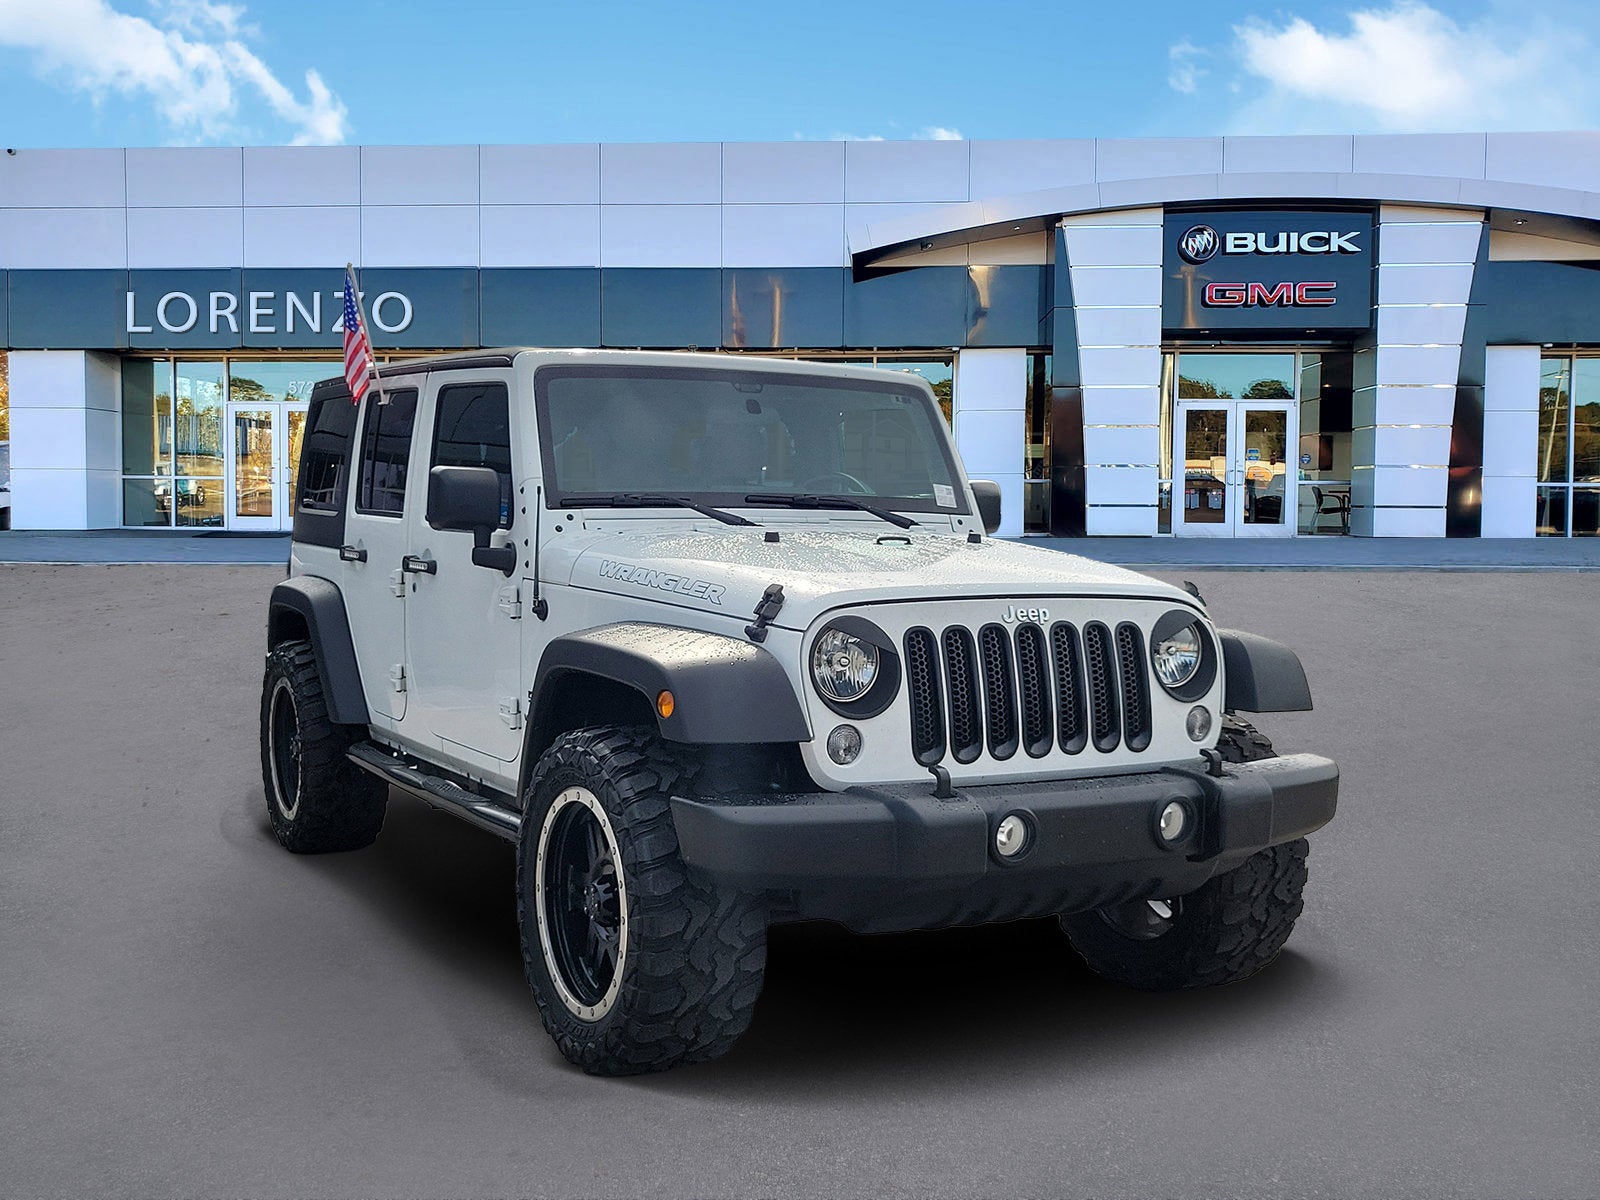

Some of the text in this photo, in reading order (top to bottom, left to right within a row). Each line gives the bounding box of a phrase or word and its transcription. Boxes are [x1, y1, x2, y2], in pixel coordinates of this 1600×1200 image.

[1225, 231, 1361, 252] BUICK
[1207, 282, 1336, 305] GMC
[599, 559, 727, 606] WRANGLER
[1001, 604, 1050, 625] Jeep
